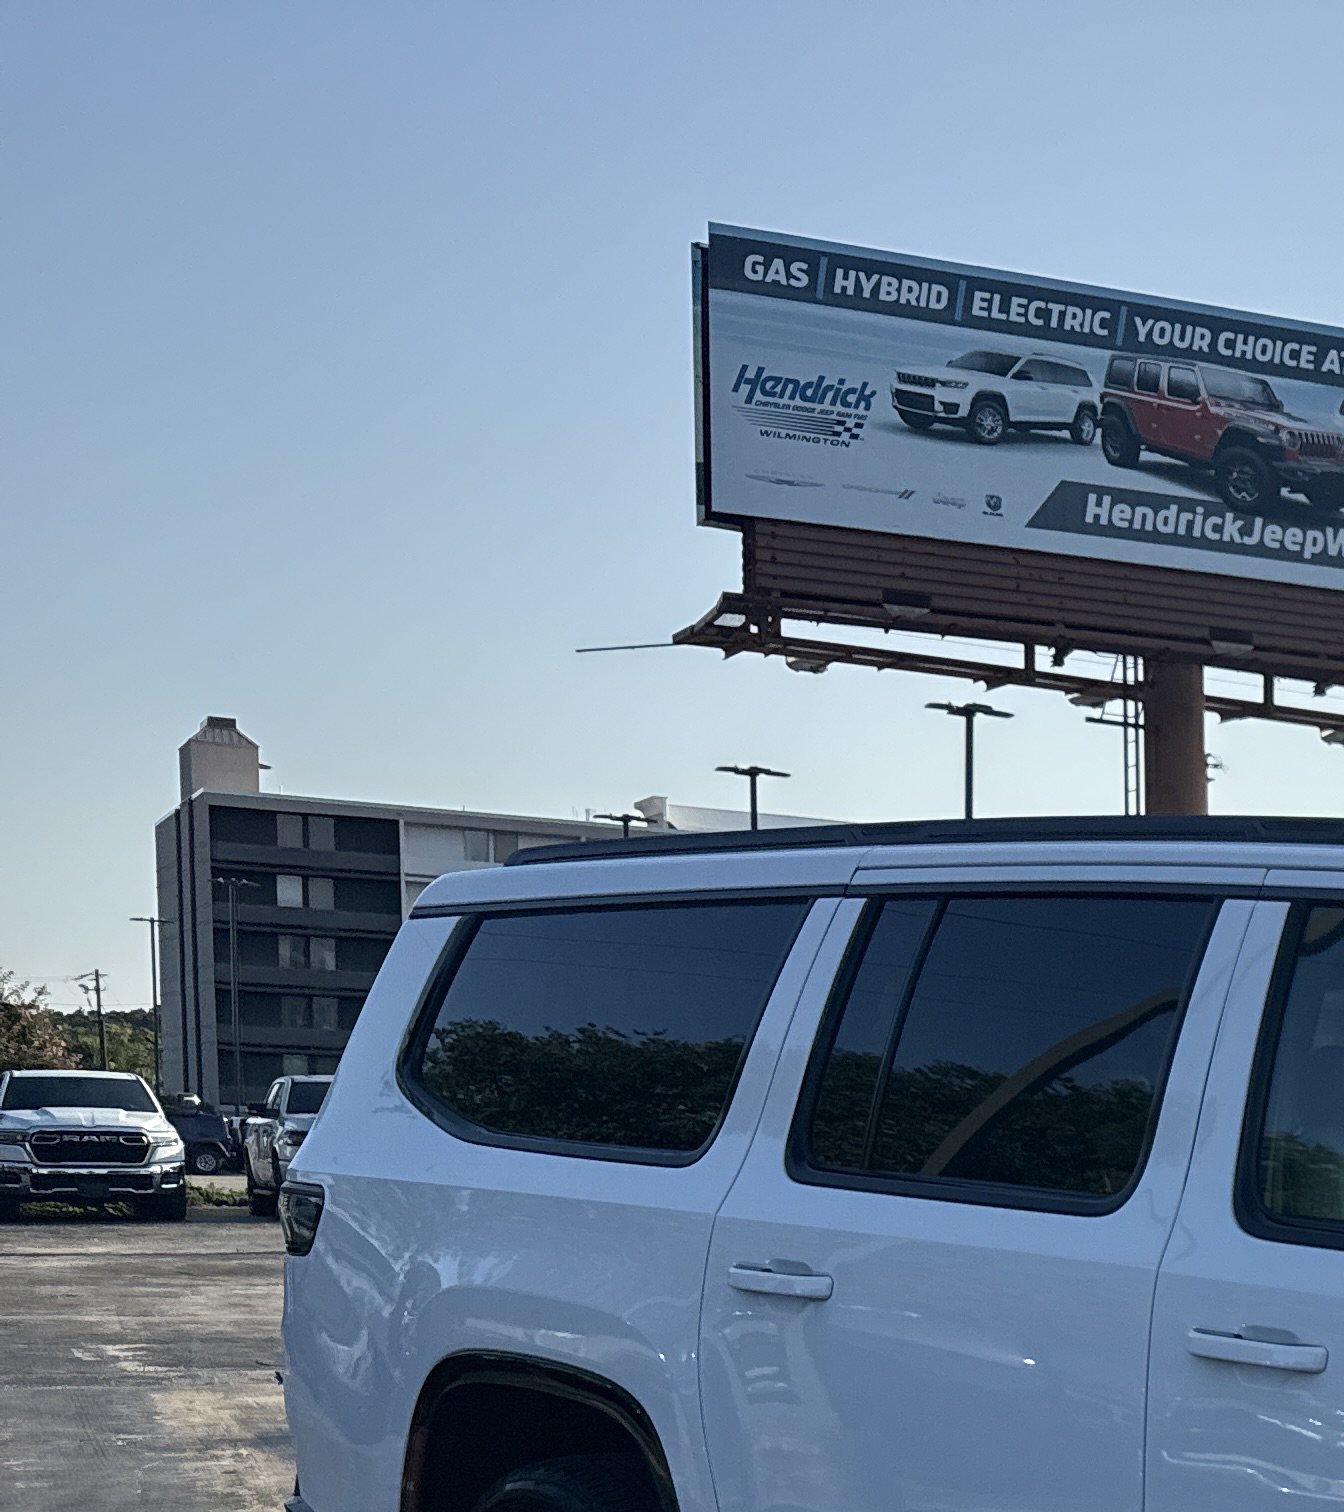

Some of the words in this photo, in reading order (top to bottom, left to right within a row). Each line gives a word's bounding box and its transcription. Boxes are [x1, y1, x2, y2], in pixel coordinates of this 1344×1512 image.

[743, 253, 809, 288] GAS
[834, 267, 949, 310] HYBRID
[971, 291, 1111, 336] ELECTRIC
[1133, 317, 1211, 353] YOUR
[1217, 330, 1317, 370] CHOICE
[731, 364, 877, 411] Hendrick
[755, 400, 791, 410] CHRYSLER
[792, 404, 817, 414] DODGE
[817, 408, 835, 416] JEEP
[759, 429, 851, 448] WILMINGTON
